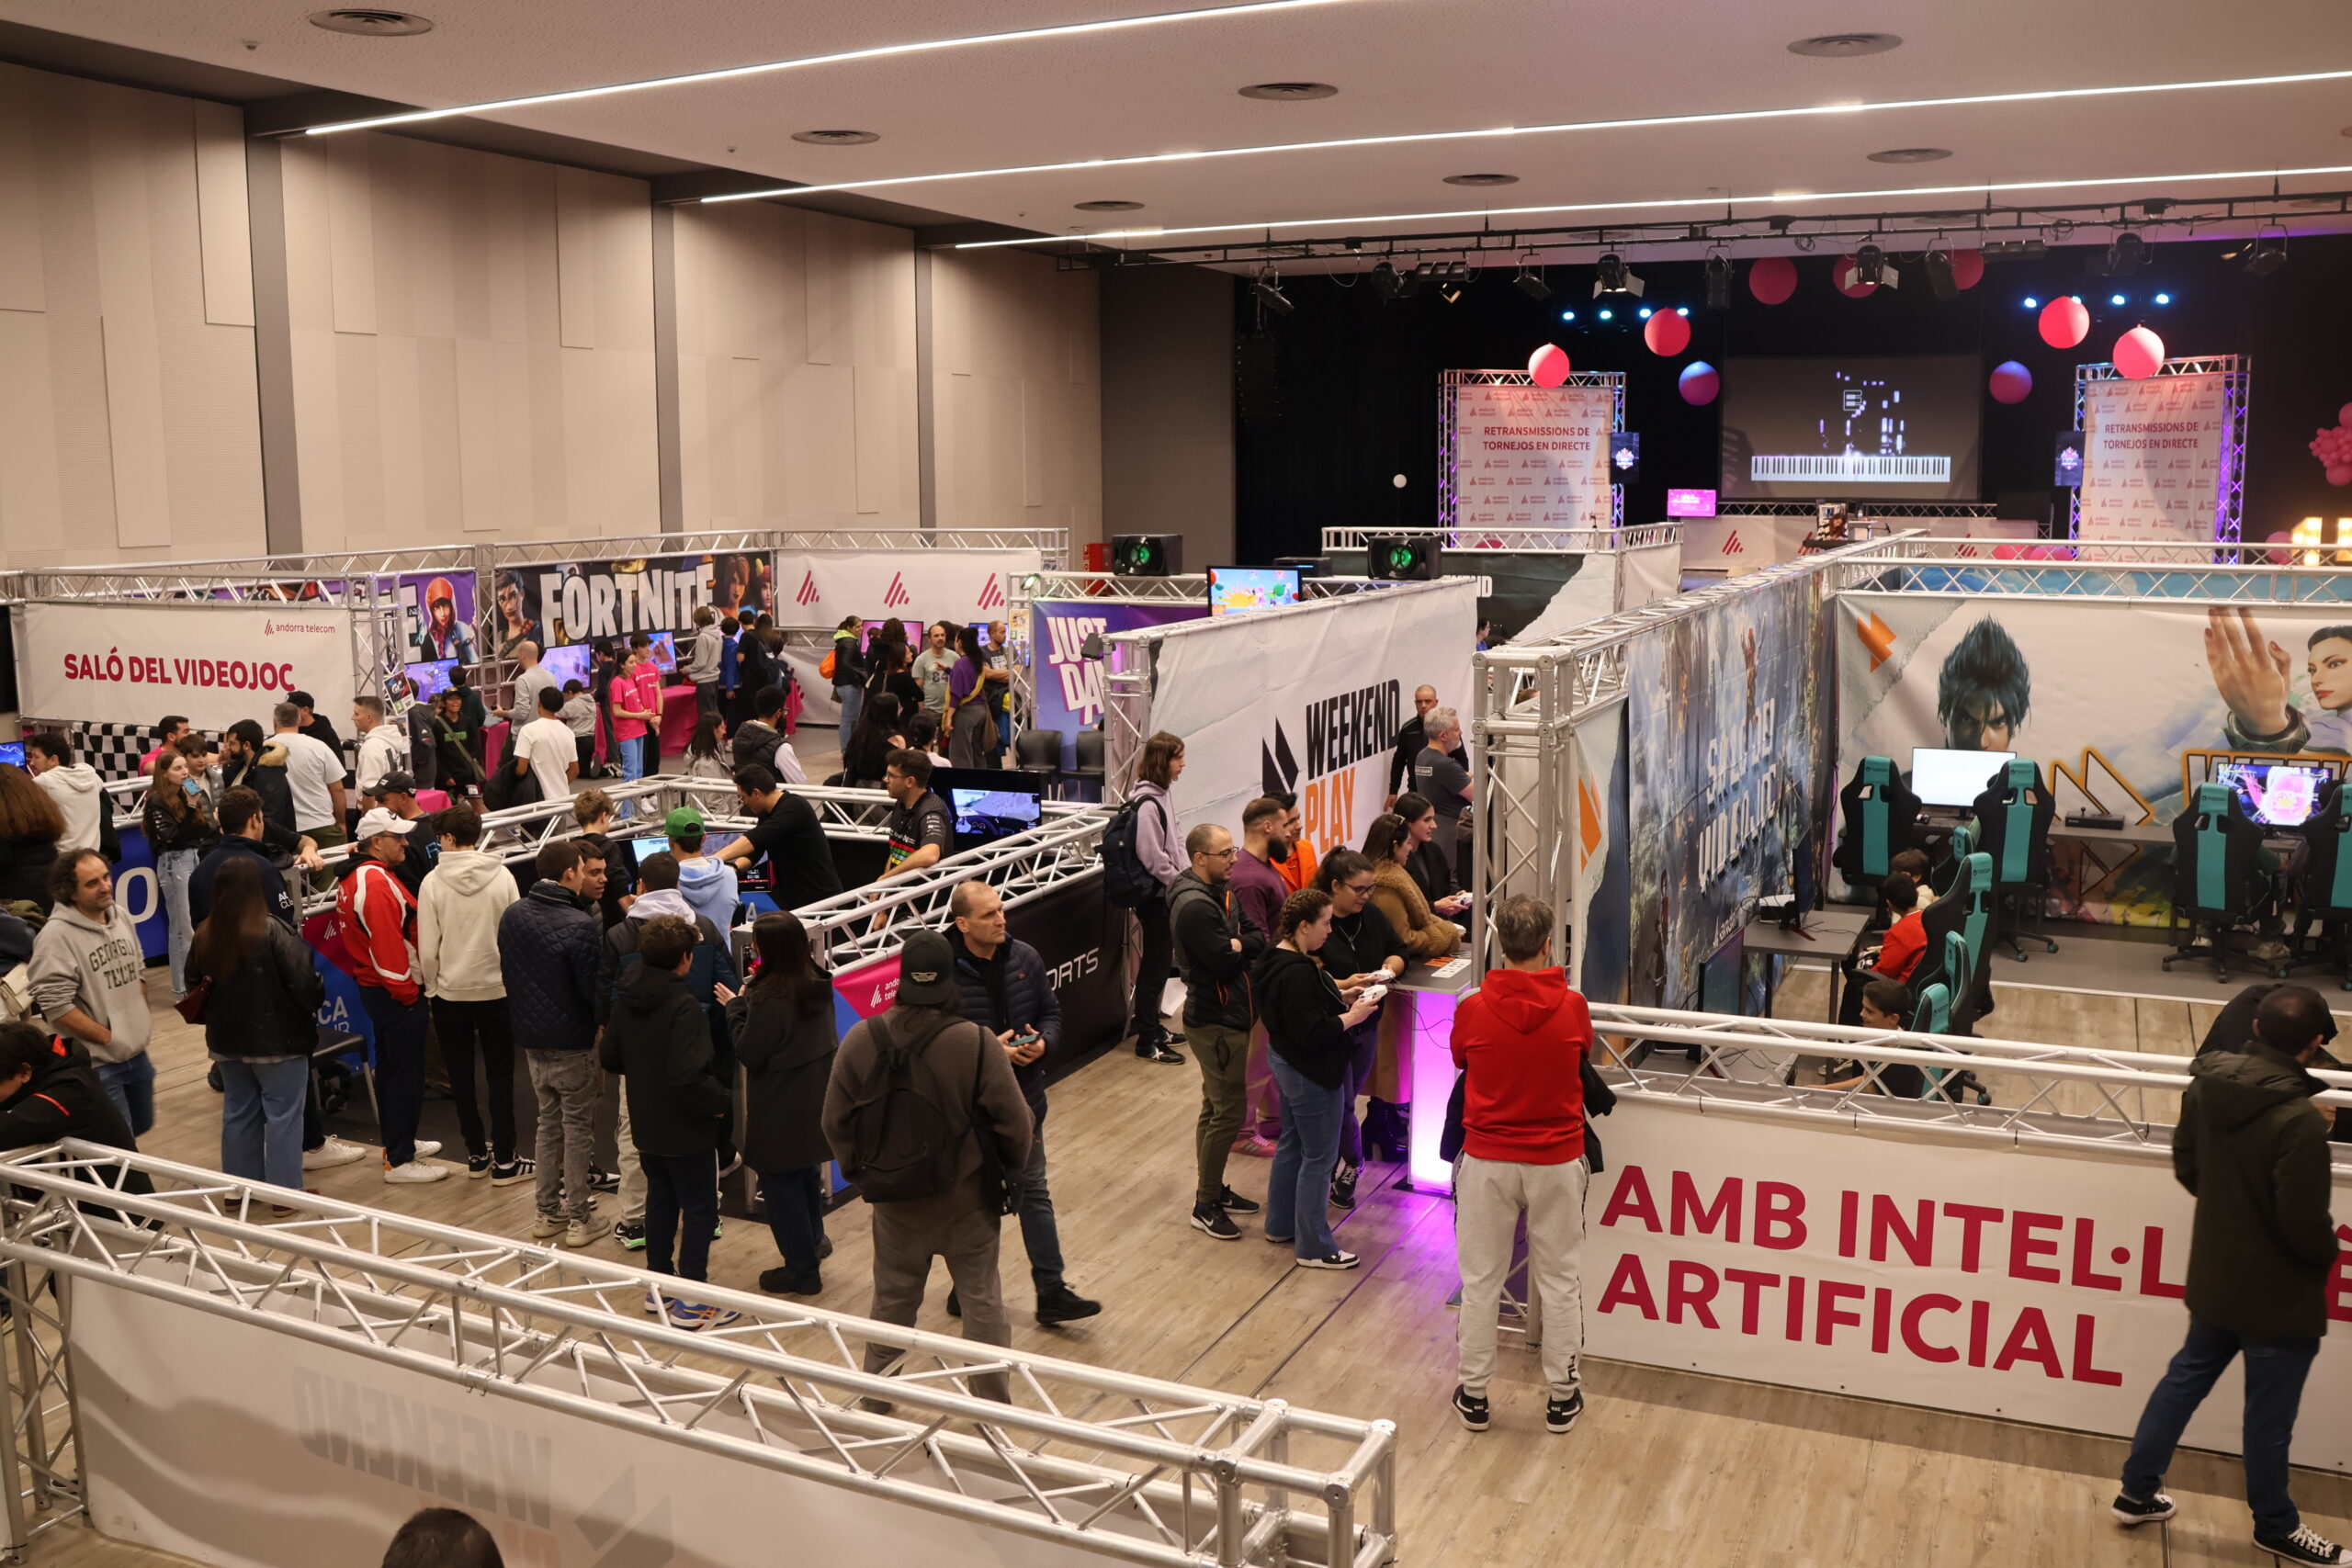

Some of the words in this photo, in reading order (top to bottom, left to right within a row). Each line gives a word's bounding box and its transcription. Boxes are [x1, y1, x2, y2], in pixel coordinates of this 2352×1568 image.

[1483, 441, 1534, 450] TORNEJOS
[1536, 441, 1549, 450] EN
[1552, 441, 1590, 450] DIRECTE
[1484, 426, 1576, 436] RETRANSMISSIONS
[1577, 427, 1590, 436] DE
[2103, 439, 2147, 449] TORNEJOS
[2149, 439, 2161, 449] EN
[2162, 438, 2199, 448] DIRECTE
[2105, 422, 2185, 434] RETRANSMISSIONS
[2187, 422, 2199, 432] DE
[540, 563, 714, 648] FORTNITE
[276, 623, 304, 632] andorra
[306, 624, 335, 634] telecom
[64, 647, 123, 682] SALÓ
[129, 656, 172, 684] DEL
[174, 659, 295, 692] VIDEOJOC
[1059, 660, 1104, 725] DA
[1306, 679, 1400, 781] WEEKEND
[1306, 766, 1356, 854] PLAY
[104, 962, 137, 989] TECH
[885, 977, 900, 990] ando
[1046, 947, 1100, 991] ORTS
[884, 989, 898, 1000] tele
[1599, 1165, 1807, 1250] AMB
[1597, 1253, 2122, 1388] ARTIFICIAL
